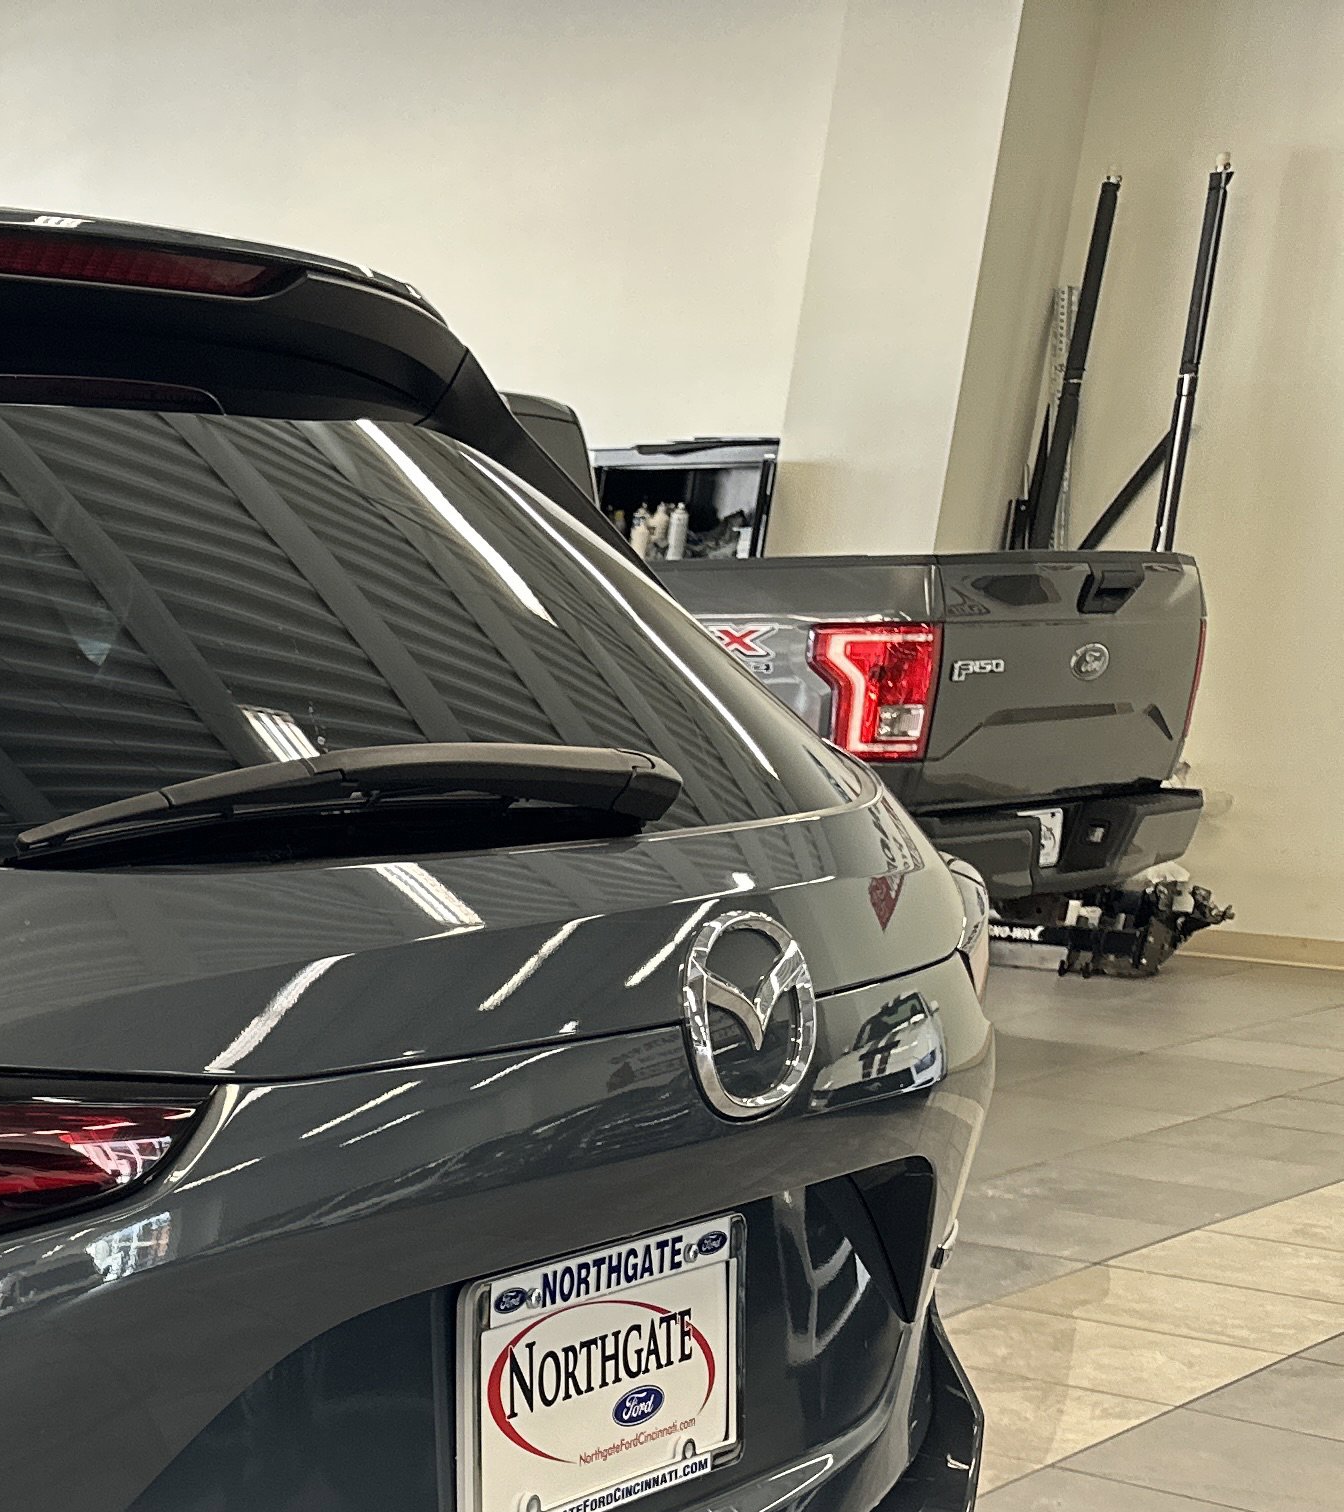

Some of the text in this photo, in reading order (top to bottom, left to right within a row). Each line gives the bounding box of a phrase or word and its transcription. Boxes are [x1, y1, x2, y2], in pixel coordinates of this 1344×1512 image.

[541, 1235, 683, 1309] NORTHGATE
[506, 1308, 694, 1420] NORTHGATE
[622, 1391, 655, 1421] Ford
[579, 1417, 696, 1467] NorthgateFordCincinnati.com
